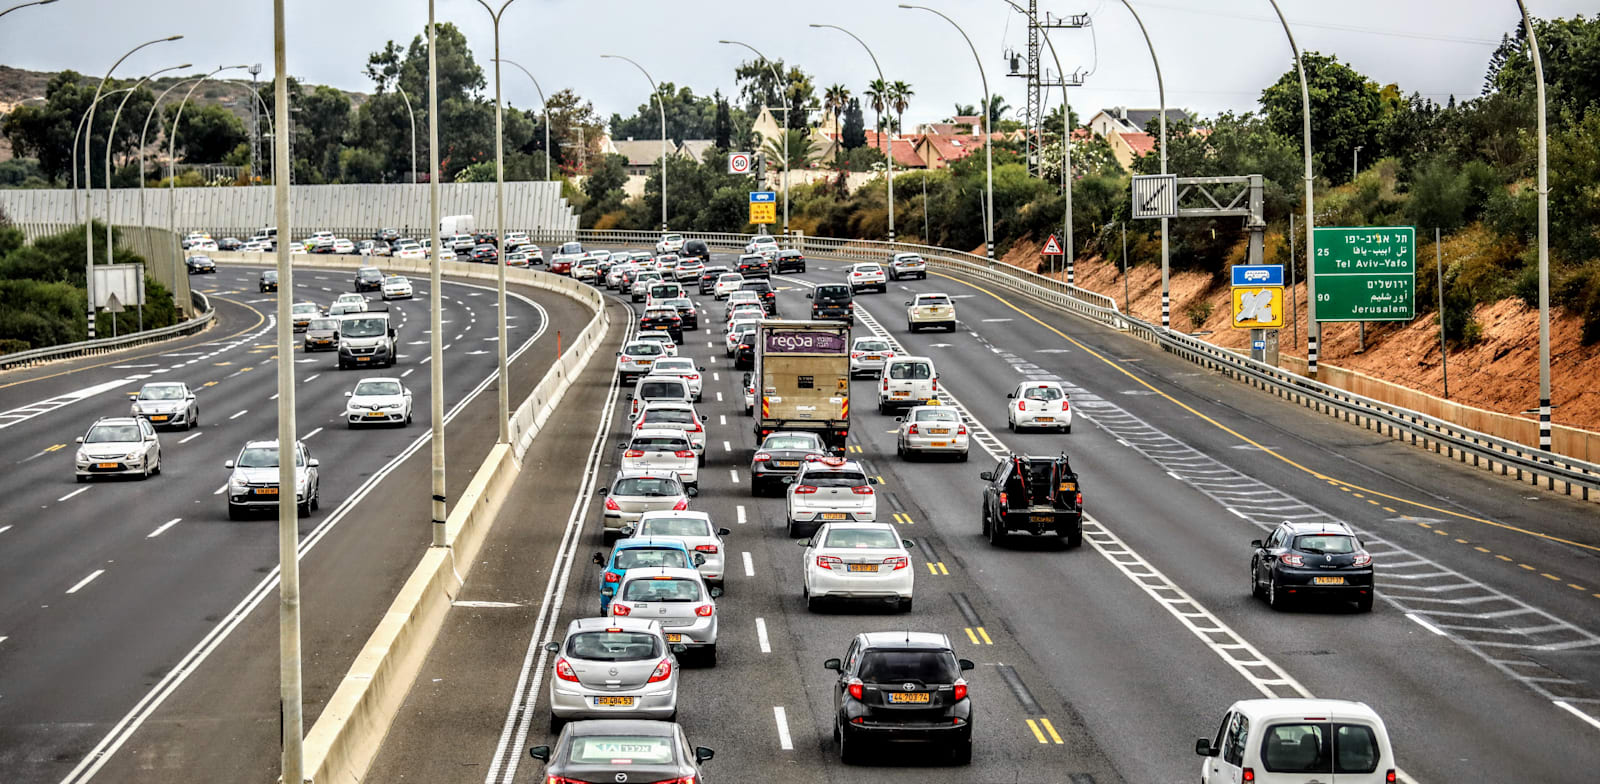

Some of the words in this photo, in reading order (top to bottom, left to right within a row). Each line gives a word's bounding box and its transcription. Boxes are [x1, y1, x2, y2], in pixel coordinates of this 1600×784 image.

[1395, 234, 1408, 243] תל
[1318, 248, 1330, 256] 25
[1336, 260, 1350, 268] Tel
[1367, 280, 1408, 288] ירושלים
[1352, 305, 1408, 313] Jerusalem
